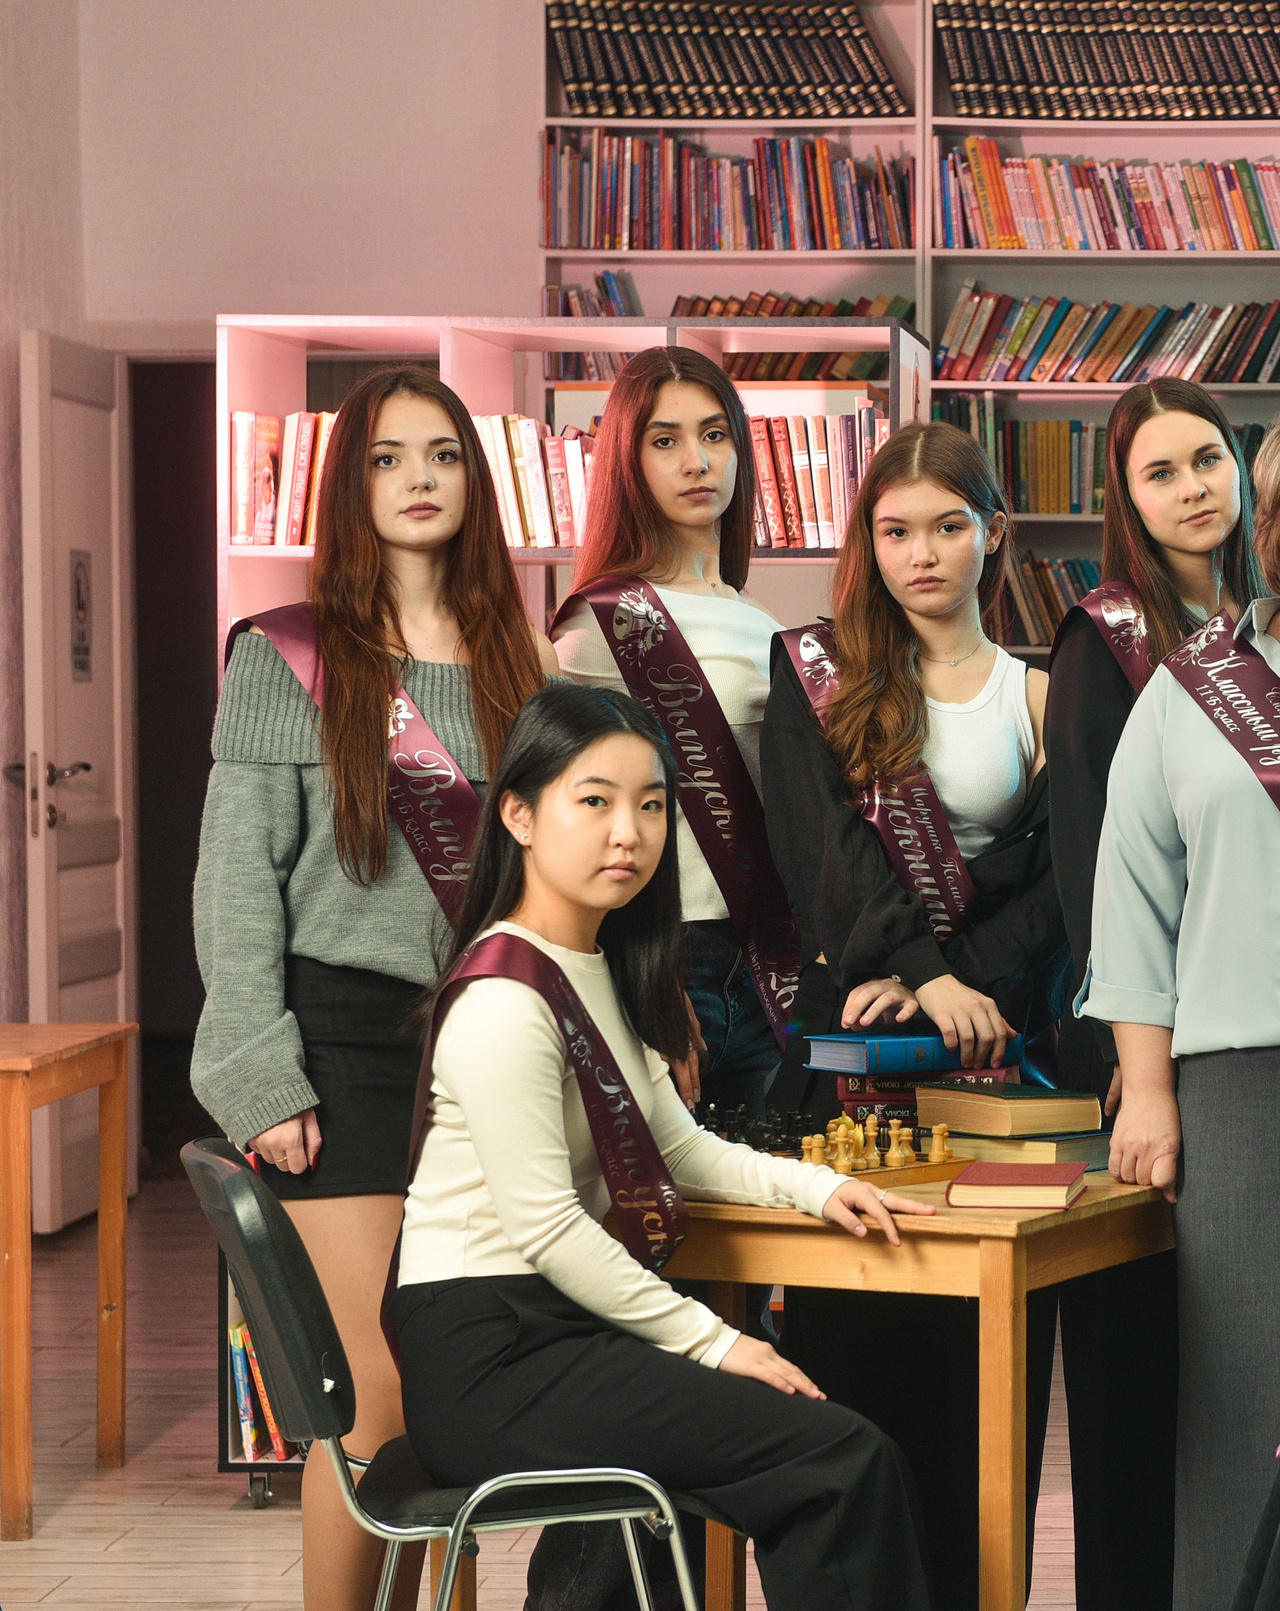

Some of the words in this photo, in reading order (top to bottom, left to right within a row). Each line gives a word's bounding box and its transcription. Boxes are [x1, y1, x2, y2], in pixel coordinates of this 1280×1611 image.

[1195, 684, 1210, 697] 11
[1206, 696, 1222, 707] Б
[1213, 706, 1241, 733] класс
[388, 784, 402, 800] 11
[405, 817, 431, 854] класс
[394, 749, 470, 886] Выпу
